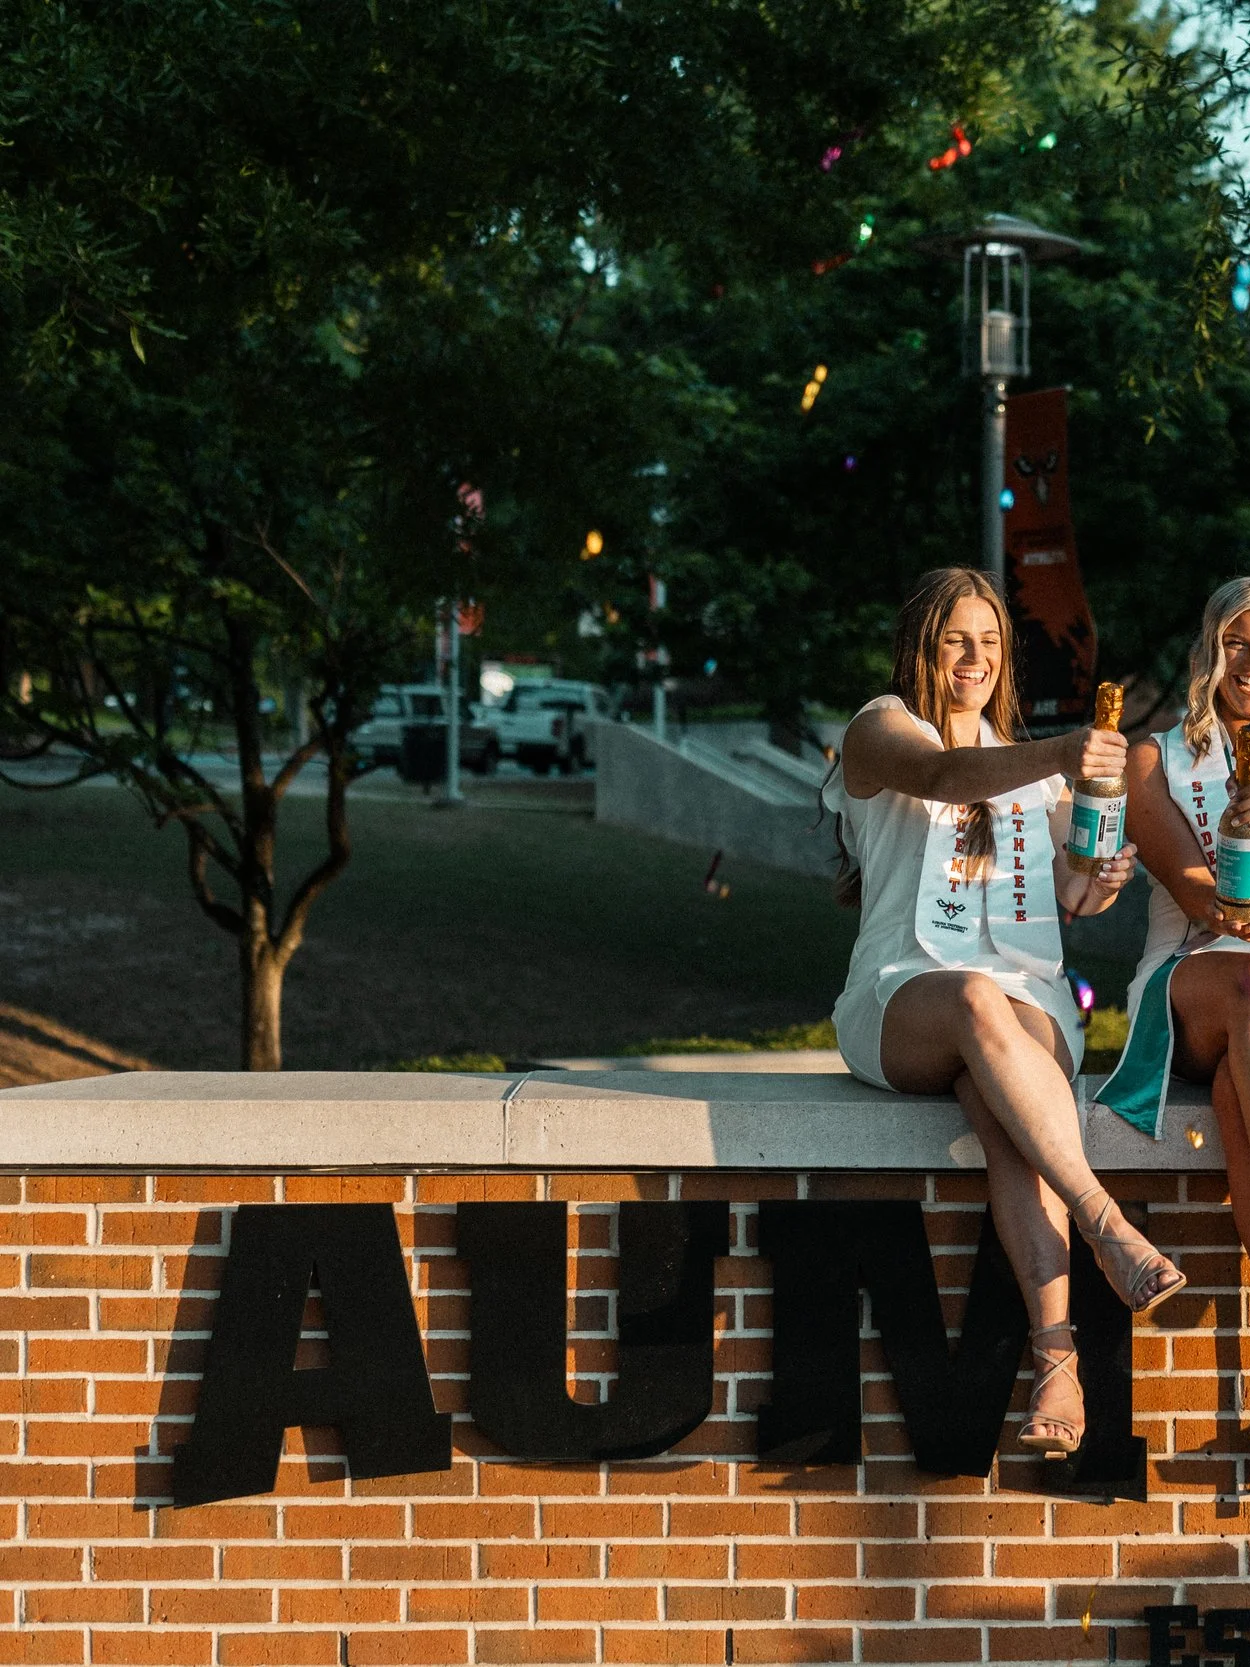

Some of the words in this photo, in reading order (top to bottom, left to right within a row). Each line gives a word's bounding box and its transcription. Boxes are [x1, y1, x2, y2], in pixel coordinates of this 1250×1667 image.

[1011, 802, 1026, 922] ATHLETE
[1192, 781, 1216, 874] STUDE
[173, 1201, 1147, 1508] AUM
